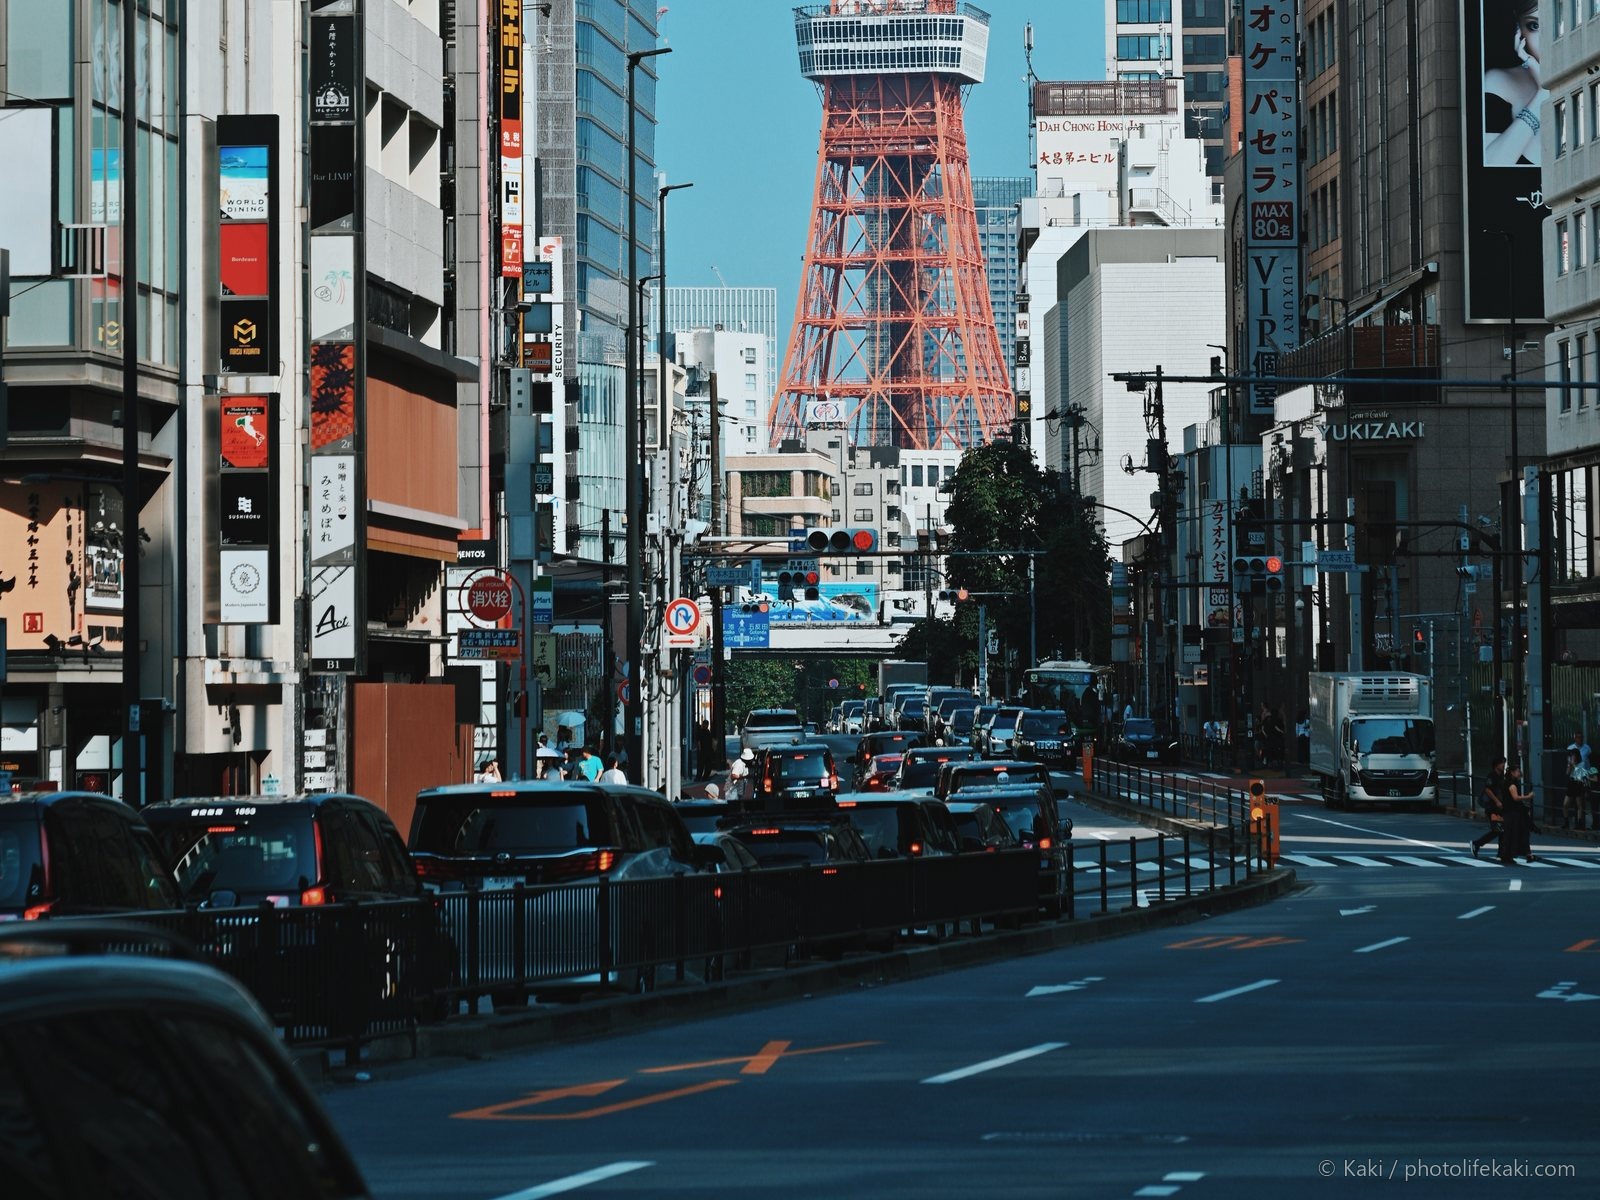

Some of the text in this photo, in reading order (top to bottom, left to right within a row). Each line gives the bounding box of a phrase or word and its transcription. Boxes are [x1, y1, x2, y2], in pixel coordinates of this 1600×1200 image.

[1039, 121, 1060, 131] DAH
[1062, 120, 1095, 132] CHONG
[1098, 120, 1123, 132] HONG
[1249, 90, 1278, 193] パセラ
[1281, 96, 1293, 188] PASELA
[328, 172, 352, 180] LIMP
[1254, 204, 1289, 218] MAX
[339, 220, 351, 229] 4F
[1282, 266, 1294, 334] LUXURY
[340, 329, 352, 339] 3F
[555, 324, 563, 377] SECURITY
[1318, 421, 1425, 441] YUKIZAKI
[341, 439, 352, 449] 2F
[536, 484, 550, 492] 3F
[321, 475, 333, 542] みそめぼれ
[1212, 502, 1226, 583] カラオケパセラ
[342, 550, 353, 559] 1F
[708, 569, 748, 579] 六本木五丁目
[472, 590, 509, 608] 消火栓
[326, 660, 340, 669] B1
